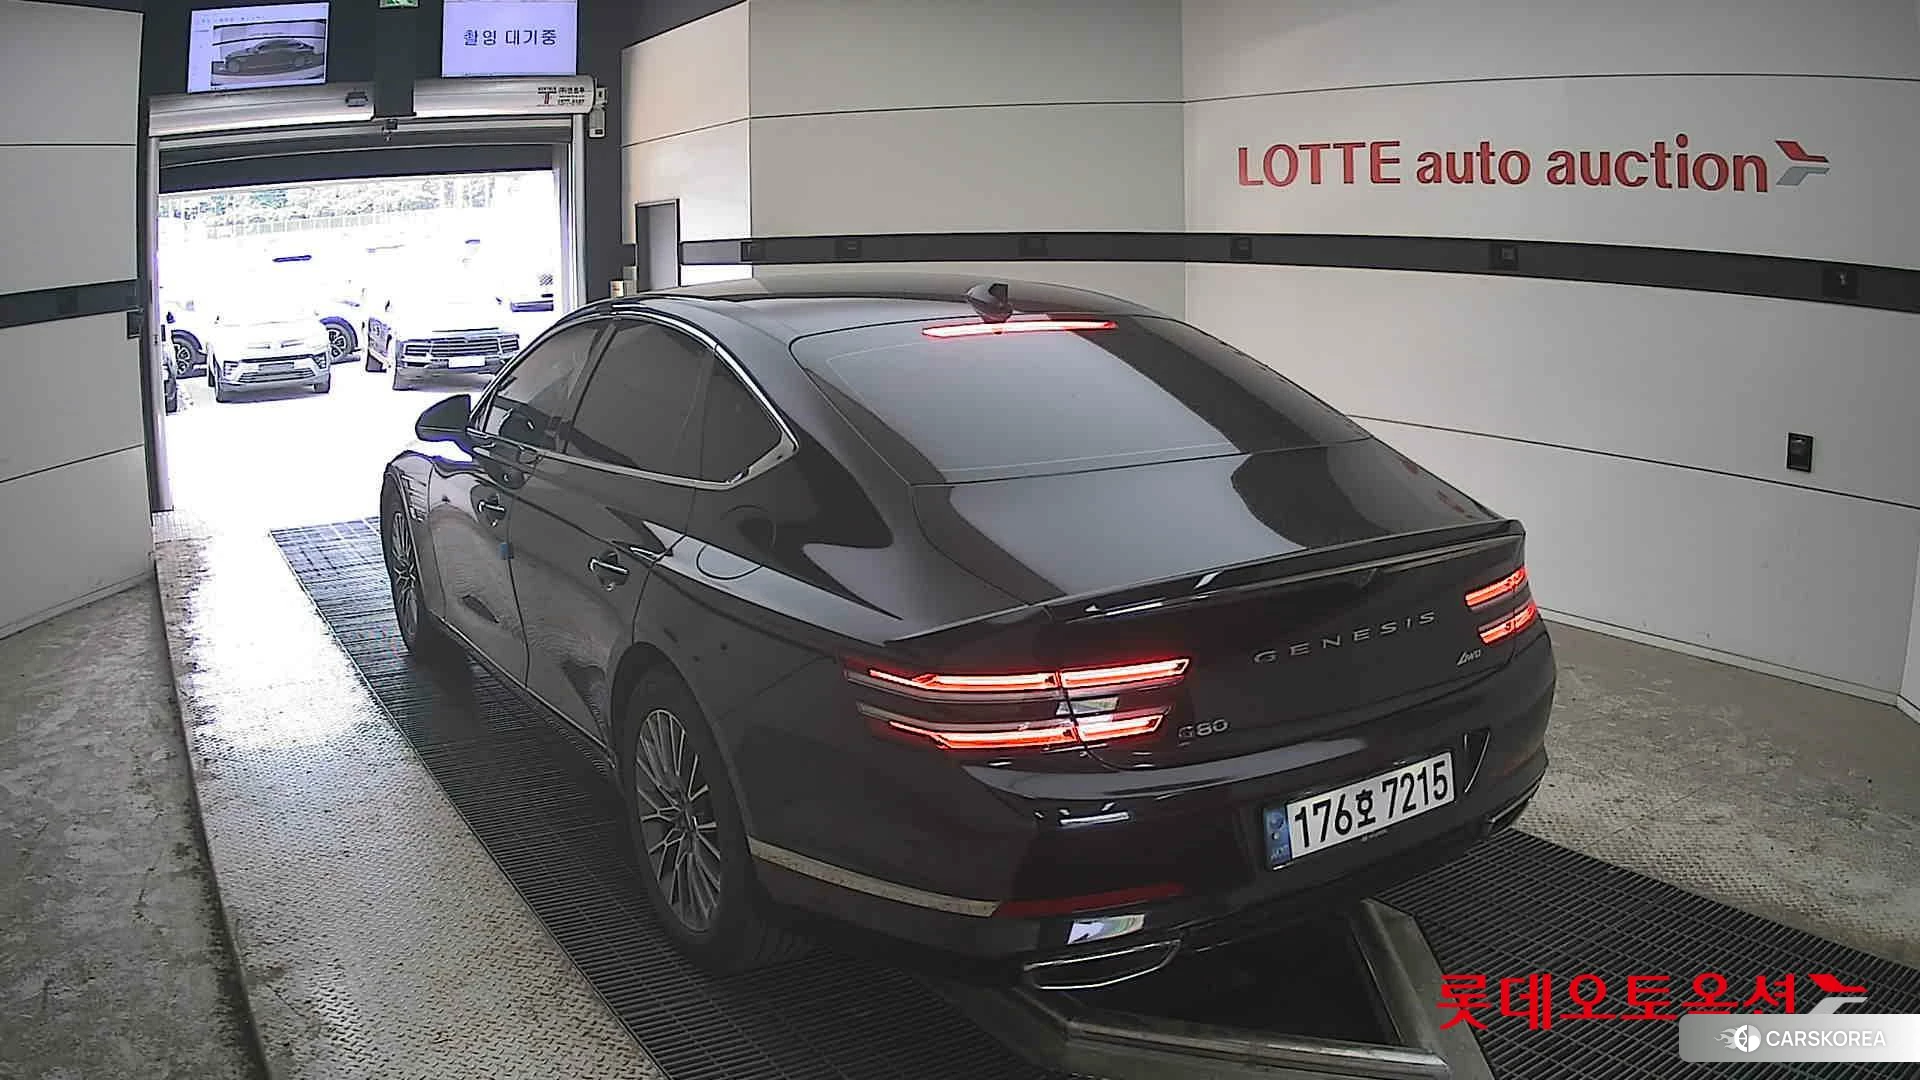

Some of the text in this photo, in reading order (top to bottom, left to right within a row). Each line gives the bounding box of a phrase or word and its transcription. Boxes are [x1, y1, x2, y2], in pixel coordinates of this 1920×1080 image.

[464, 29, 557, 46] 촬영 대기중
[1239, 133, 1768, 193] LOTTE auto auction
[1253, 611, 1436, 664] GENESIS
[1178, 719, 1229, 739] G80
[1382, 761, 1448, 819] 7215
